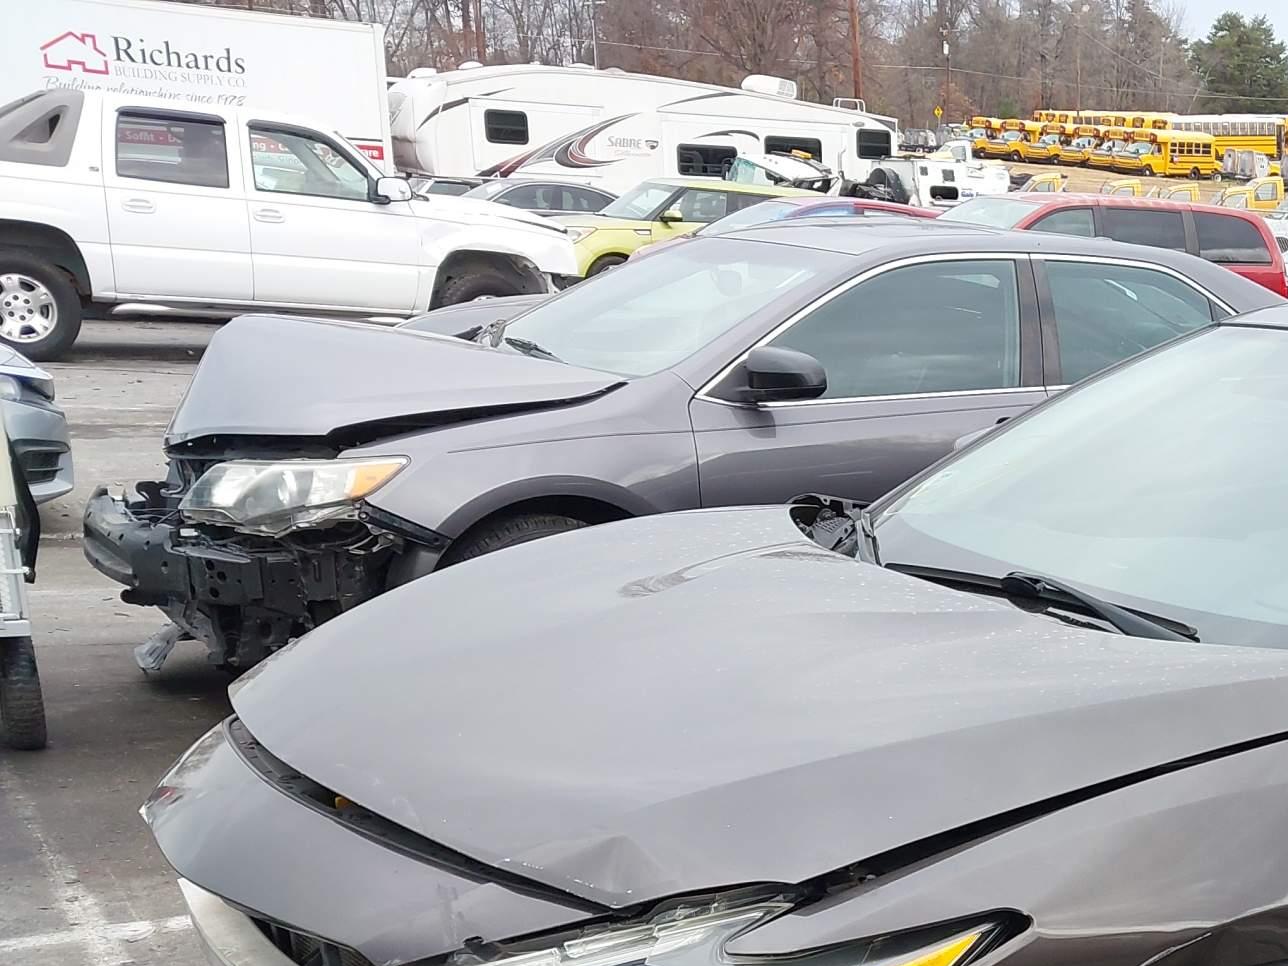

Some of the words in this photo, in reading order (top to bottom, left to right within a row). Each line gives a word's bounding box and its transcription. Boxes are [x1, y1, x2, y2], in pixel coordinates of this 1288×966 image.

[110, 35, 247, 75] Richards
[113, 65, 178, 83] BUILDING
[180, 73, 225, 87] SUPPLY
